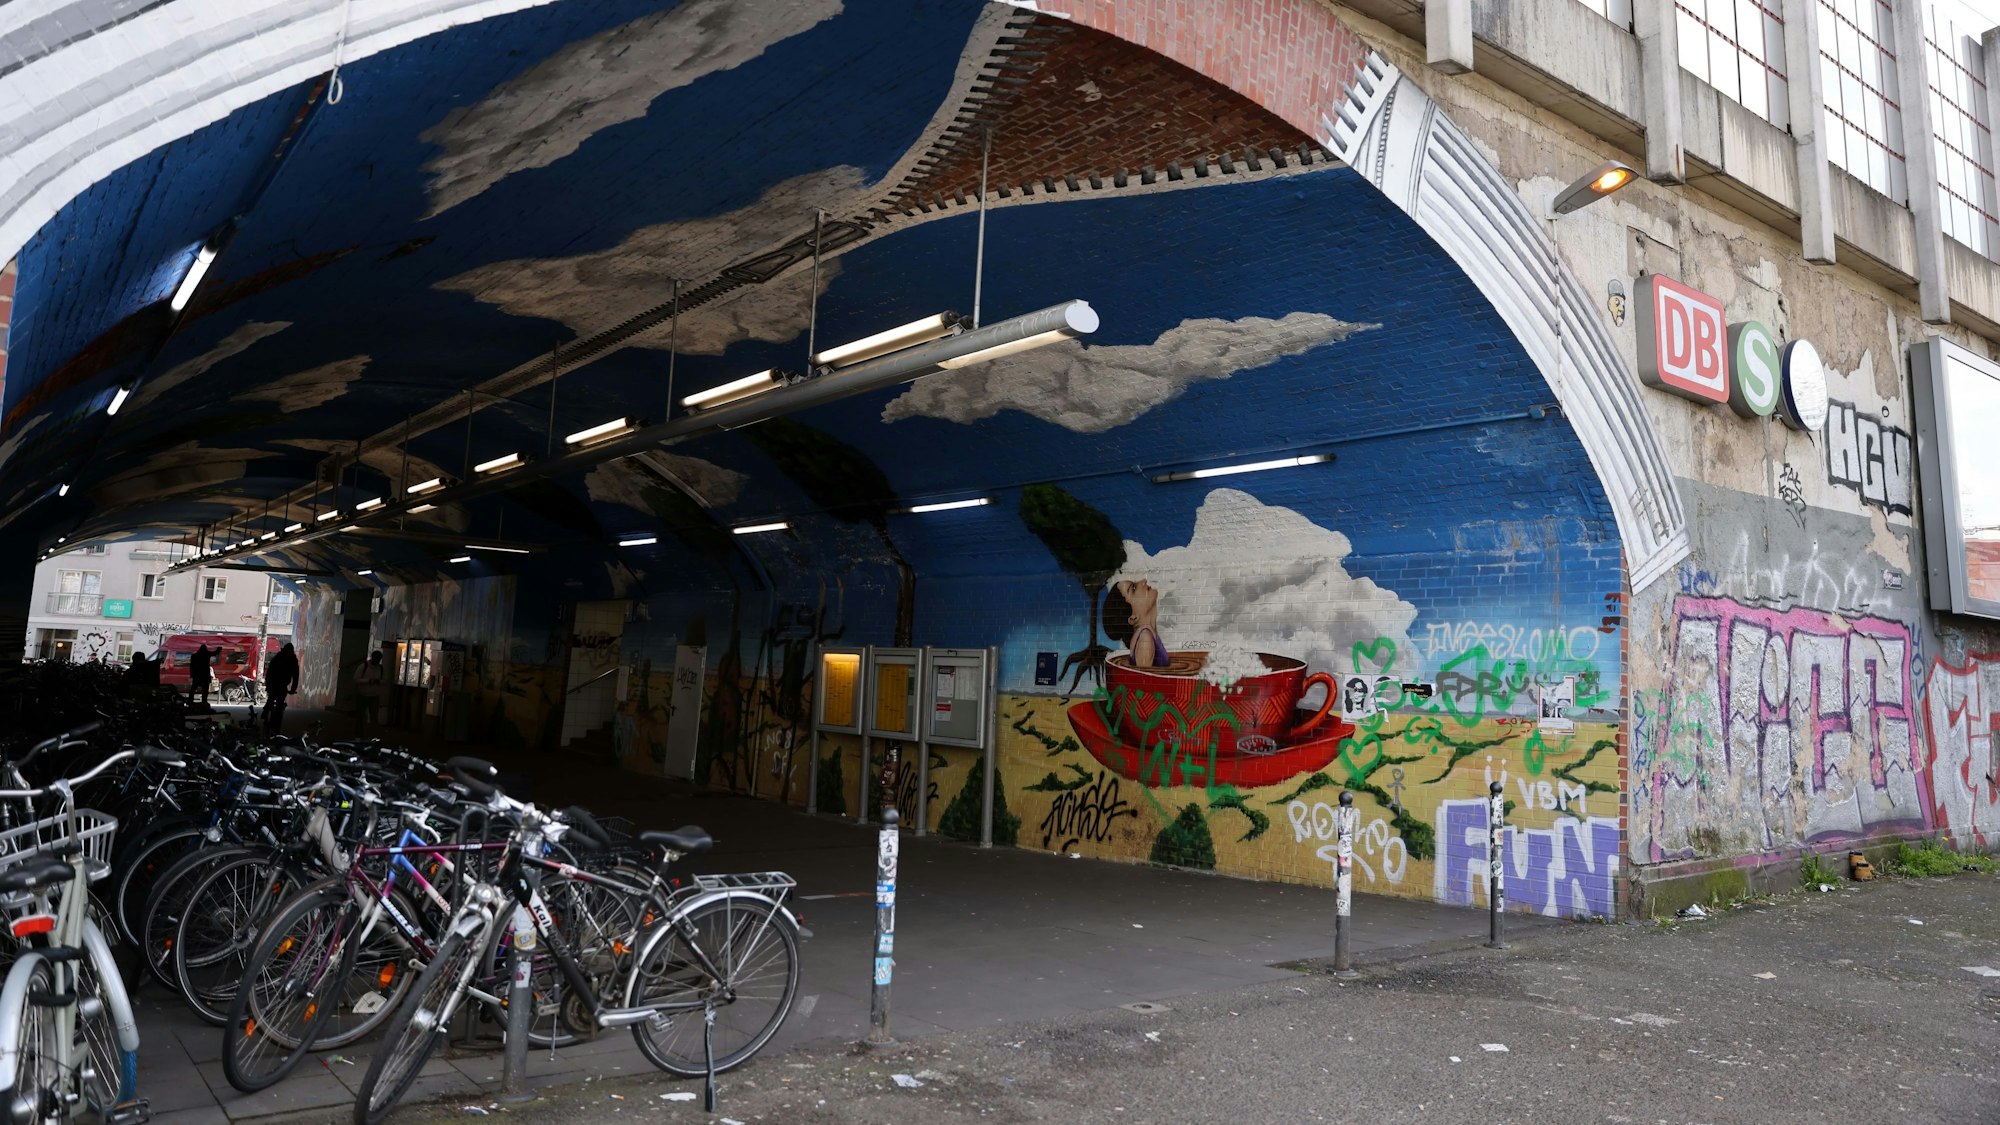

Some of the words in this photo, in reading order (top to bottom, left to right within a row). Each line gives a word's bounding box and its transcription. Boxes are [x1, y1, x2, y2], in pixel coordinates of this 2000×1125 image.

[1663, 294, 1721, 380] DB
[1743, 328, 1774, 408] S
[1517, 777, 1587, 813] VBM
